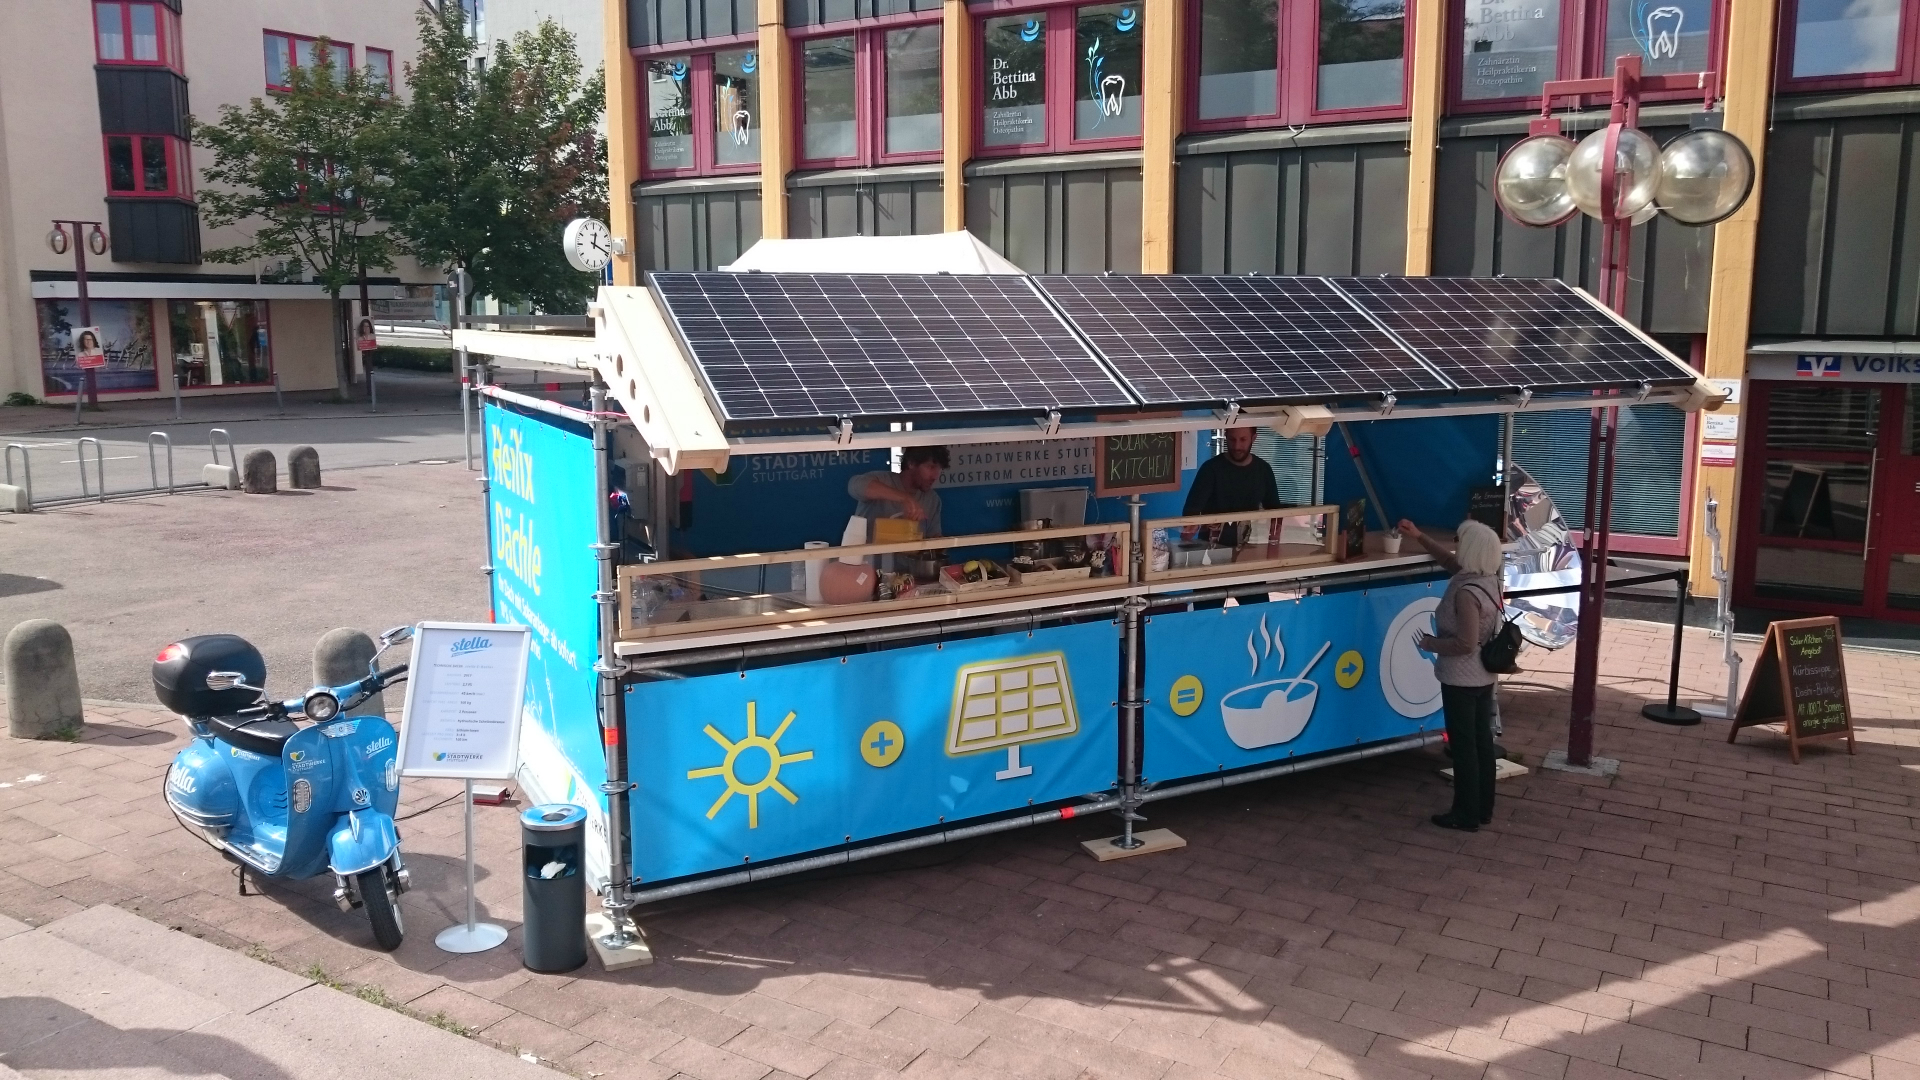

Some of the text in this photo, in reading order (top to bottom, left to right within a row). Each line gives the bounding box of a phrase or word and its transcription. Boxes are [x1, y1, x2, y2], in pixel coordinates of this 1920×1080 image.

[1480, 6, 1544, 24] Bettina
[1477, 24, 1515, 42] Abb
[993, 58, 1009, 70] Dr.
[1477, 56, 1520, 66] Zahnärztin
[993, 70, 1036, 85] Bettina
[1477, 65, 1536, 77] Heilpraktikerin
[1476, 76, 1523, 86] Osteopathin
[992, 84, 1017, 100] Abb
[1109, 435, 1149, 452] SOLAR
[752, 450, 871, 471] STADTWERKE
[958, 449, 1050, 466] STADTWERKE
[752, 468, 825, 484] STUTTGART
[939, 468, 1013, 484] ÖKOSTROM
[1020, 465, 1067, 479] CLEVER
[1110, 455, 1172, 481] KITCHEN
[495, 501, 542, 596] Dächle
[450, 636, 493, 653] stella
[366, 736, 393, 755] stella
[169, 761, 198, 794] stella
